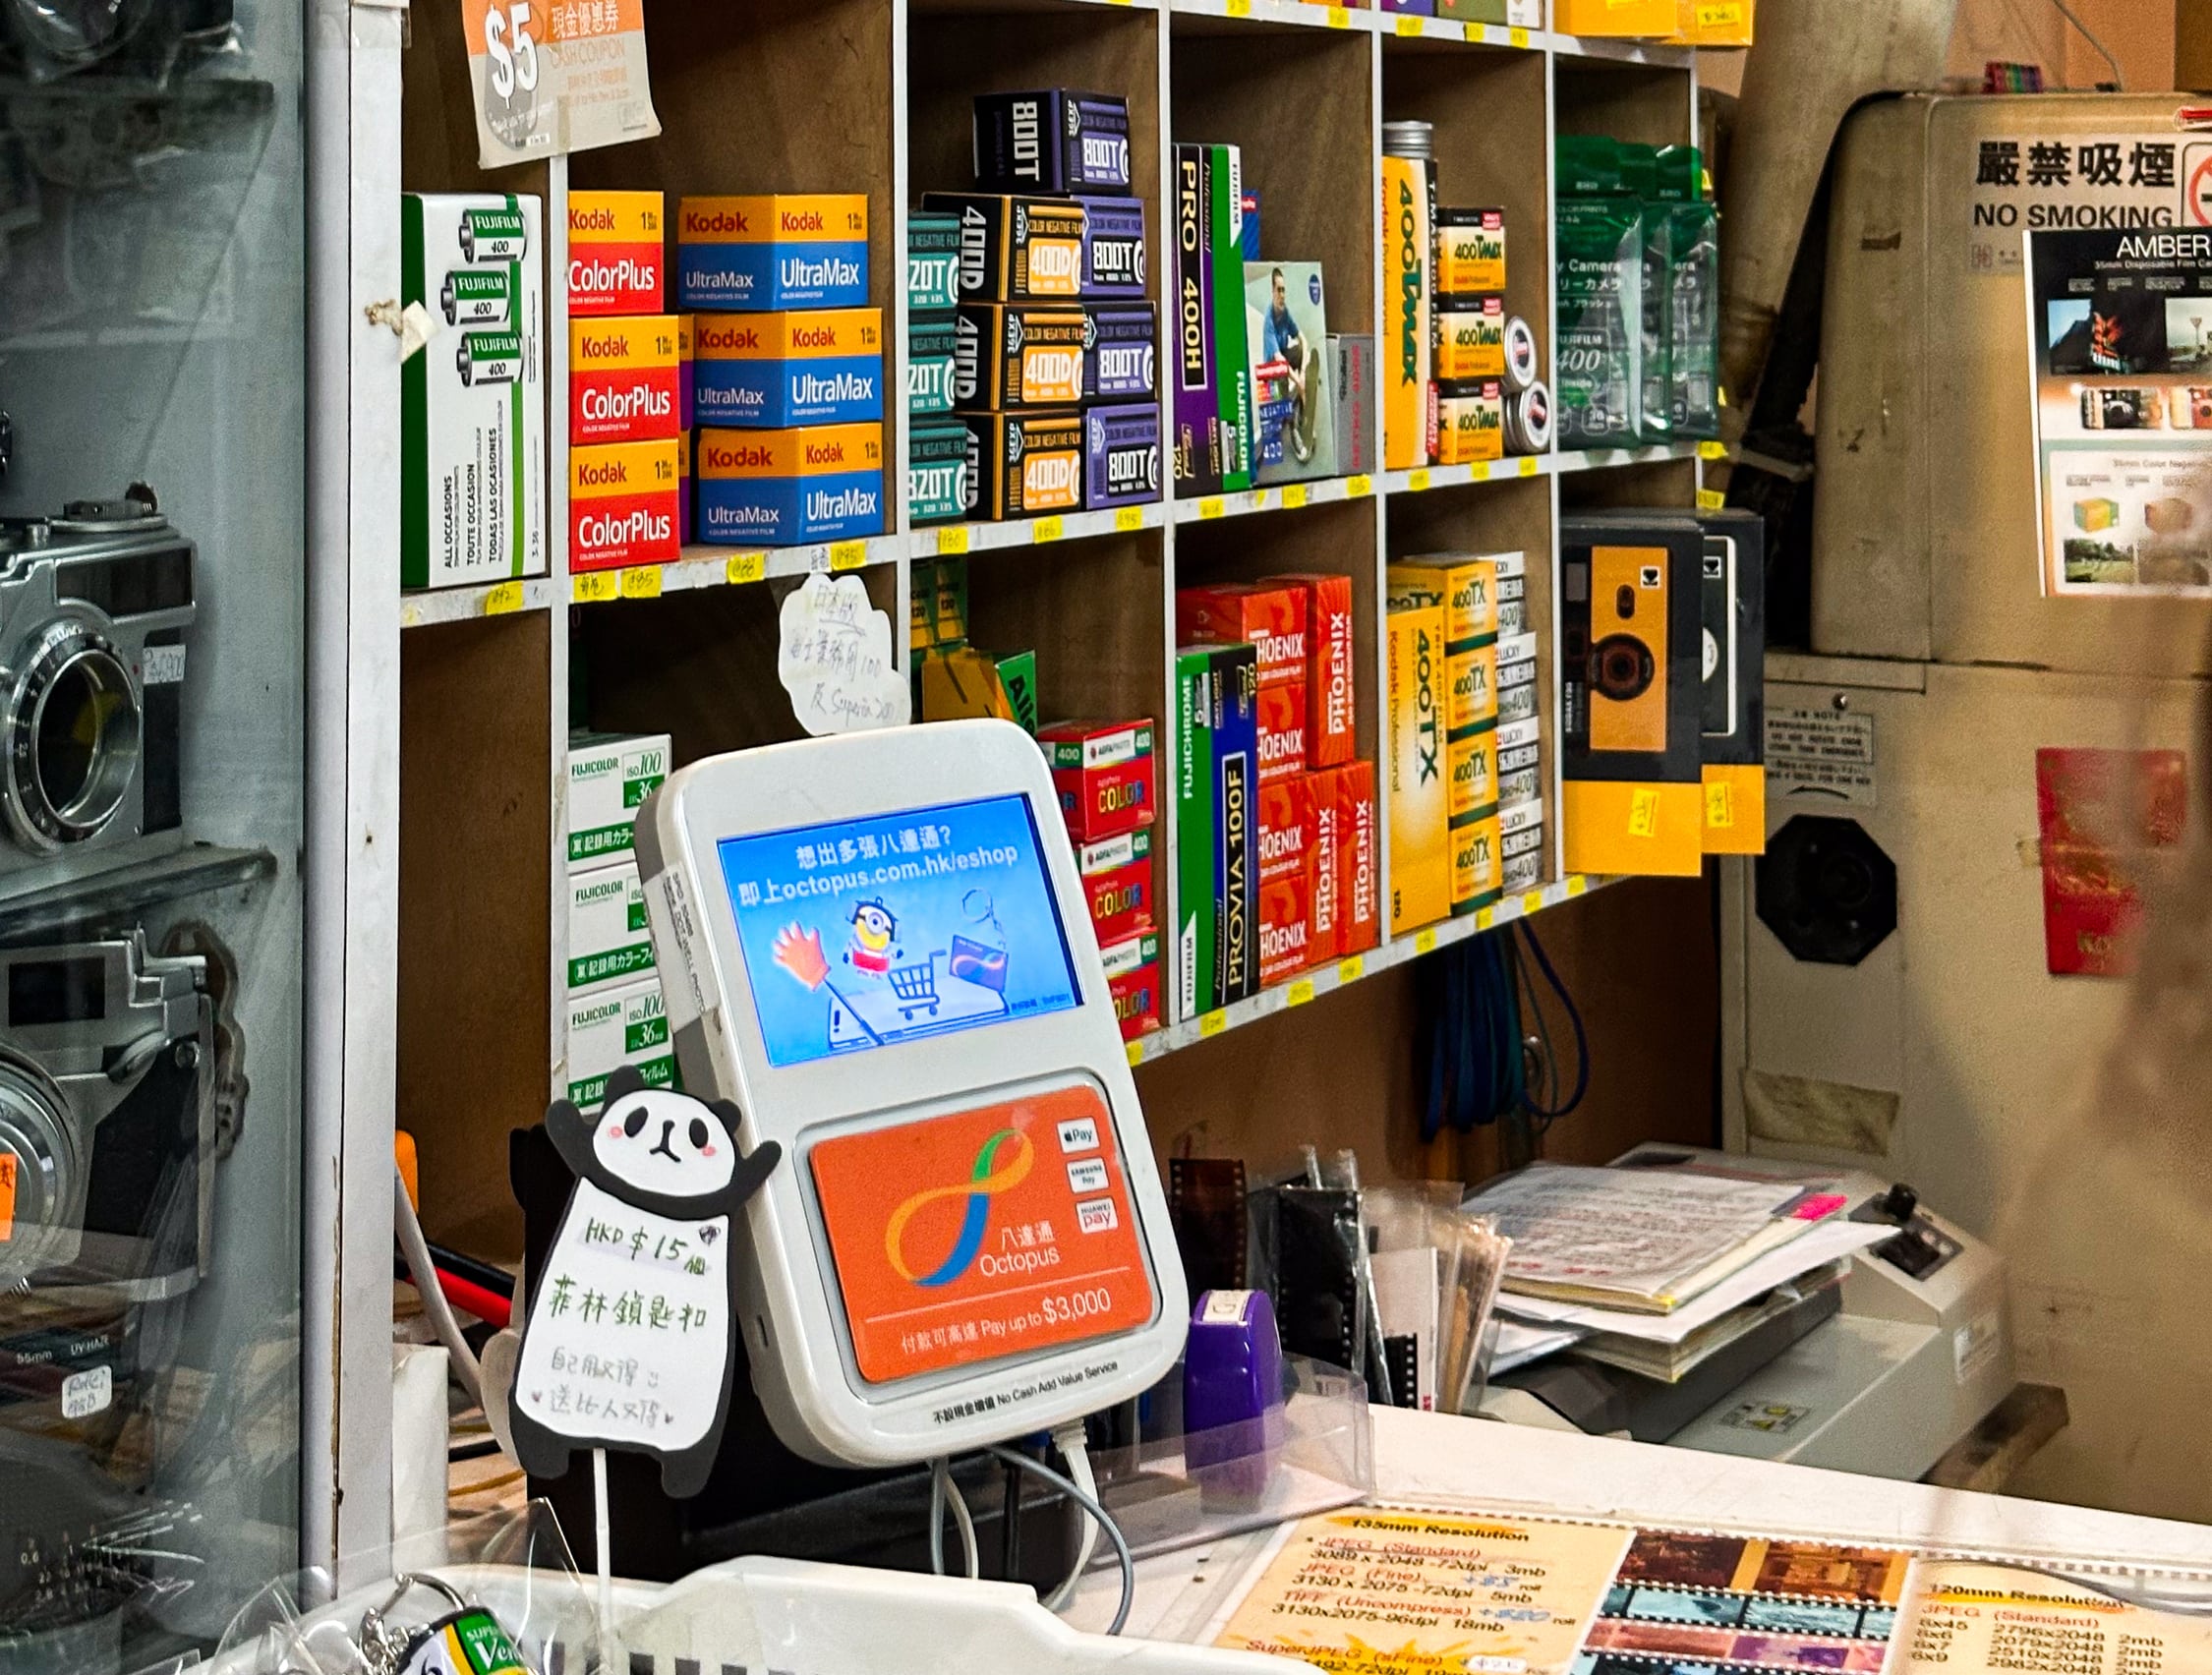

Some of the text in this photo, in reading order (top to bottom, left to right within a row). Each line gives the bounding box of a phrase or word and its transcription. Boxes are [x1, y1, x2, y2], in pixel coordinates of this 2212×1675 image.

[484, 2, 539, 110] $5
[1013, 101, 1040, 182] 800T
[1083, 138, 1119, 168] 800T
[1976, 141, 2176, 187] 嚴禁吸煙
[475, 214, 521, 230] FUJIFILM
[568, 209, 614, 230] Kodak
[686, 211, 748, 232] Kodak
[782, 211, 824, 231] Kodak
[1973, 203, 2173, 229] NO SMOKING
[492, 240, 509, 254] 400
[960, 204, 987, 290] 400D
[1092, 241, 1133, 271] 800T
[2116, 235, 2211, 259] AMBER
[782, 258, 860, 288] UltraMax
[1031, 244, 1072, 277] 400D
[1182, 161, 1202, 370] PRO 400H
[1568, 259, 1621, 273] Camera
[2177, 260, 2195, 268] Film
[457, 276, 504, 292] FUJIFILM
[568, 259, 656, 292] ColorPlus
[686, 270, 754, 288] UltraMax
[473, 302, 492, 316] 400
[473, 336, 518, 353] FUJIFILM
[582, 335, 629, 359] Kodak
[698, 327, 760, 349] Kodak
[792, 326, 836, 348] Kodak
[488, 364, 506, 376] 400
[955, 315, 979, 400] 400D
[1024, 352, 1072, 385] 400D
[1099, 349, 1142, 379] 800T
[697, 387, 765, 405] UltraMax
[791, 373, 873, 404] UltraMax
[582, 383, 670, 421] ColorPlus
[1236, 371, 1249, 472] FUJICOLOR
[707, 445, 774, 467] Kodak
[806, 442, 844, 465] Kodak
[1263, 441, 1283, 459] 400
[578, 461, 626, 487] Kodak
[1026, 459, 1070, 491] 400D
[1109, 449, 1147, 482] 800T
[489, 428, 497, 564] TODAS LAS OCASIONES
[806, 487, 876, 521] UltraMax
[443, 475, 453, 568] ALL OCCASIONS
[466, 464, 476, 566] TOUTE OCCASION
[708, 505, 780, 524] UltraMax
[579, 509, 670, 549] ColorPlus
[1452, 579, 1486, 609] 400TX
[1500, 645, 1521, 662] LUCKY
[1331, 611, 1346, 733] PHOENIX
[1454, 664, 1486, 697] 400TX
[1416, 628, 1439, 787] 400TX
[1135, 730, 1151, 748] 400
[1183, 675, 1193, 800] FUJICHROME
[1391, 699, 1401, 792] Professional
[1502, 728, 1523, 745] LUCKY
[639, 751, 662, 776] 100
[1058, 747, 1080, 761] 400
[1453, 749, 1486, 782] 400TX
[571, 756, 618, 778] FUJICOLOR
[1097, 780, 1145, 814] COLOR
[1505, 811, 1526, 830] LUCKY
[1133, 834, 1149, 852] 400
[1456, 837, 1490, 870] 400TX
[1318, 806, 1332, 932] PHOENIX
[1355, 798, 1369, 923] PHOENIX
[1228, 770, 1244, 986] PROVIA 100F
[576, 880, 623, 902] FUJICOLOR
[1094, 882, 1142, 920] COLOR
[1141, 938, 1157, 957] 400
[572, 1001, 621, 1025] FUJICOLOR
[642, 996, 665, 1019] 100
[638, 1027, 656, 1050] 36
[1073, 1127, 1093, 1143] Pay
[1080, 1202, 1111, 1215] HUAWEI
[1082, 1212, 1111, 1229] pay
[585, 1217, 624, 1244] HKD
[1000, 1219, 1056, 1252] 八達通
[979, 1245, 1061, 1278] Octopus
[549, 1273, 707, 1333] 菲林鎖匙扣
[979, 1319, 1007, 1338] Pay
[1009, 1314, 1027, 1332] up
[1028, 1311, 1043, 1326] to
[1042, 1287, 1112, 1325] $3,000
[997, 1392, 1012, 1406] No
[1013, 1383, 1037, 1402] Cash
[1038, 1377, 1057, 1393] Add
[1058, 1371, 1083, 1387] Value
[1084, 1359, 1119, 1380] Service
[1353, 1518, 1530, 1542] 135mm Resolution
[1318, 1536, 1482, 1559] JPEG (Standard)
[1300, 1562, 1356, 1576] JPEG
[1376, 1555, 1425, 1567] 2048
[1504, 1563, 1546, 1578] 3mb
[1292, 1574, 1341, 1588] 3130
[1336, 1595, 1472, 1618] (Uncompress)
[1922, 1603, 2100, 1629] JPEG (Standard)
[2117, 1645, 2163, 1658] 2mb
[2118, 1633, 2164, 1647] 2mb
[2116, 1656, 2162, 1670] 2mb
